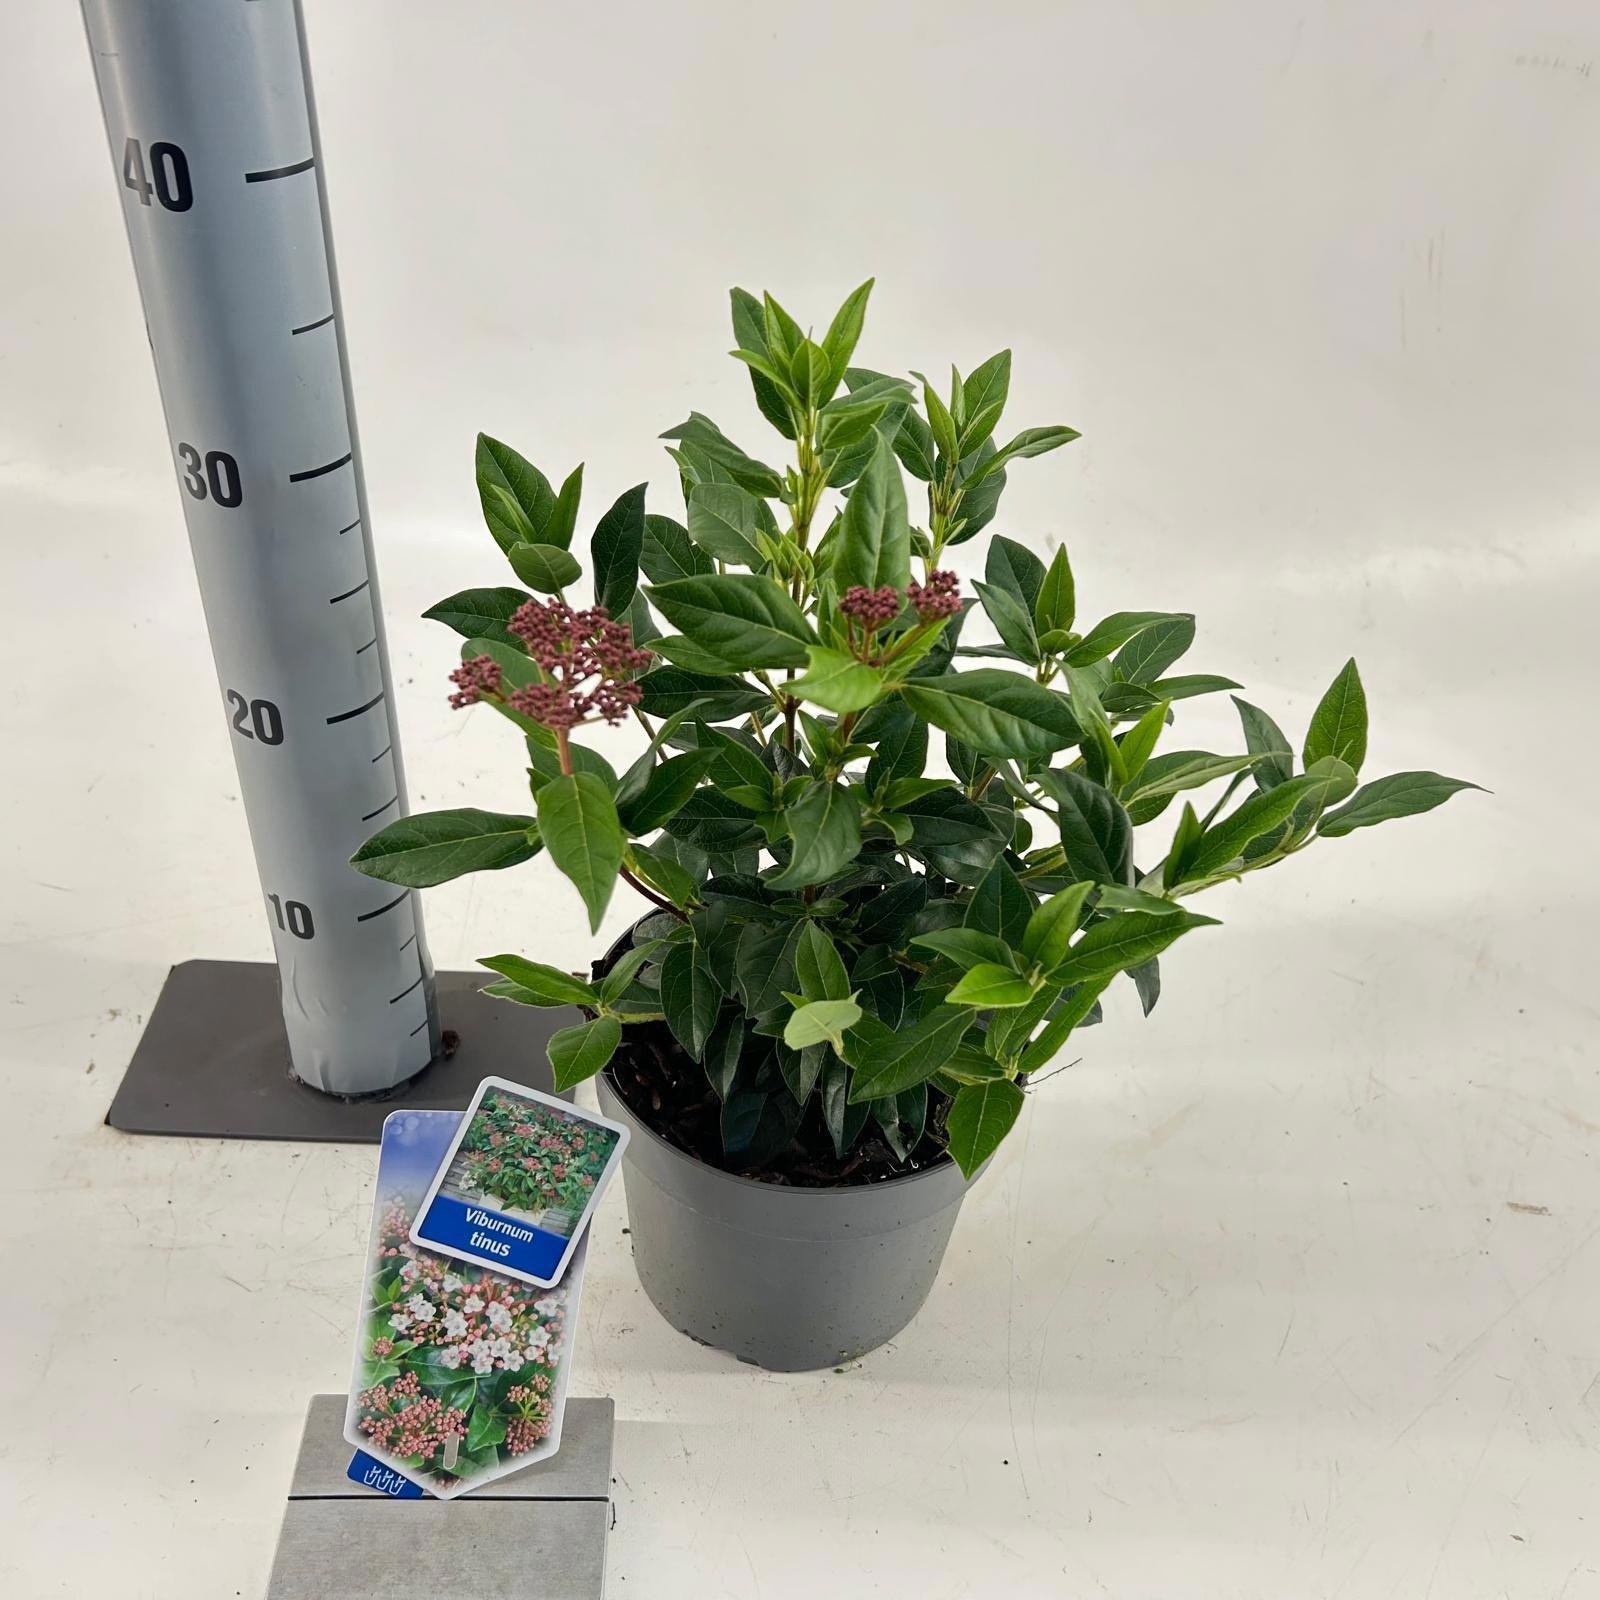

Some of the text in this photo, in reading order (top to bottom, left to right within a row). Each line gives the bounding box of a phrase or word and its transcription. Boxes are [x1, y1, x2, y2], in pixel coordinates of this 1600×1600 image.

[123, 137, 194, 213] 40
[179, 442, 243, 508] 30
[226, 689, 285, 746] 20
[267, 893, 315, 940] 10
[465, 1208, 534, 1243] Viburnum
[470, 1231, 511, 1257] tinus
